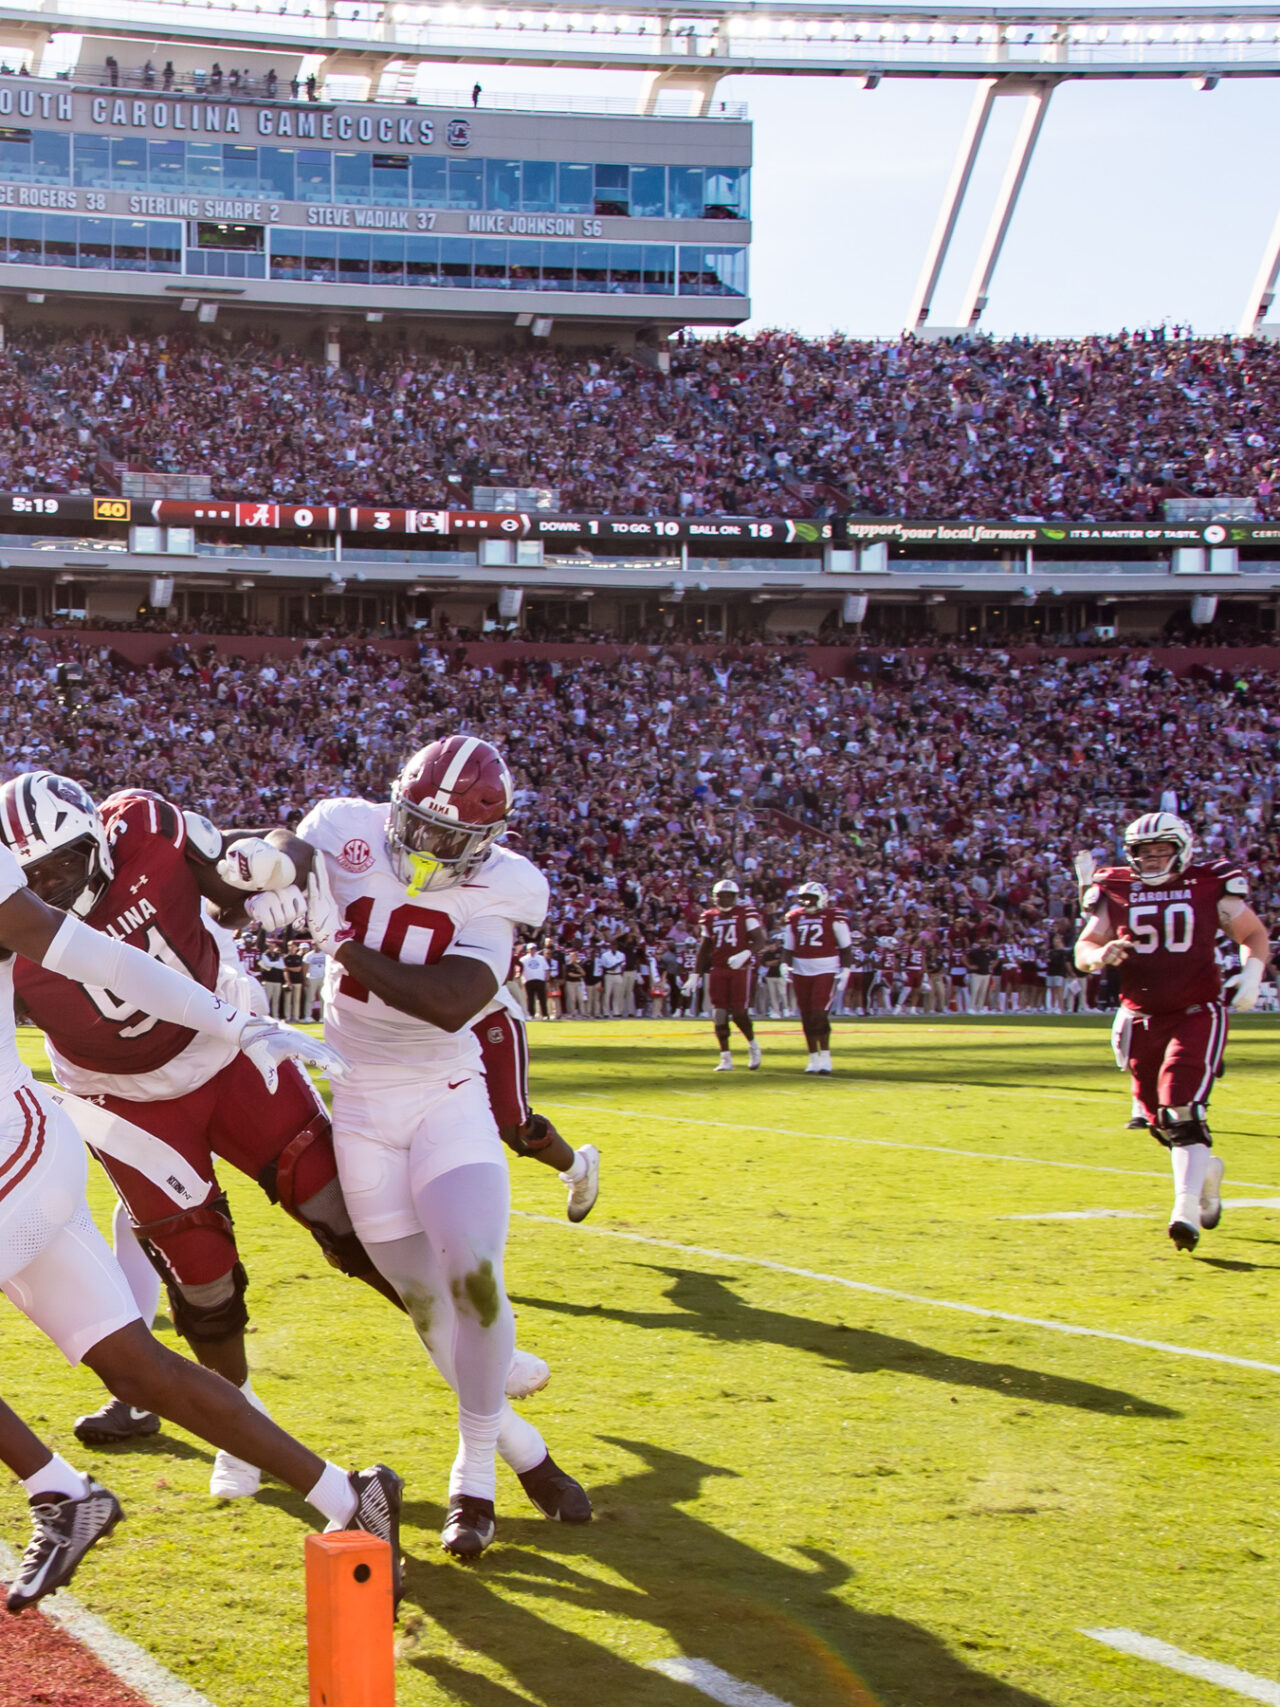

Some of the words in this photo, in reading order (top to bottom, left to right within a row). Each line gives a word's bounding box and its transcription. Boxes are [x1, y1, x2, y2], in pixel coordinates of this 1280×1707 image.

[93, 97, 241, 133] CAROLINA
[258, 109, 434, 144] GAMECOCKS
[20, 187, 77, 209] ROGERS
[86, 193, 106, 210] 38
[130, 197, 198, 217] STERLING
[205, 201, 261, 221] SHARPE
[270, 205, 280, 222] 2
[308, 207, 350, 226] STEVE
[354, 209, 408, 229] WADIAK
[417, 213, 437, 230] 37
[468, 214, 504, 232] MIKE
[509, 216, 574, 235] JOHNSON
[583, 220, 602, 237] 56
[12, 497, 58, 513] 5:19
[97, 501, 125, 517] 40
[373, 511, 391, 529] 3
[588, 520, 599, 534] 1
[655, 521, 679, 536] 10
[690, 526, 718, 535] BALL
[748, 524, 773, 538] 18
[900, 525, 937, 542] your
[937, 525, 974, 539] local
[972, 526, 1037, 542] farmers
[1091, 530, 1100, 538] A
[1101, 530, 1143, 538] MATTER
[1144, 530, 1161, 538] OF
[344, 839, 369, 865] SEC
[1129, 889, 1192, 903] CAROLINA
[99, 897, 158, 941] LINA
[1128, 902, 1195, 954] 50
[713, 924, 738, 948] 74
[797, 924, 824, 946] 72
[339, 896, 455, 1003] 10
